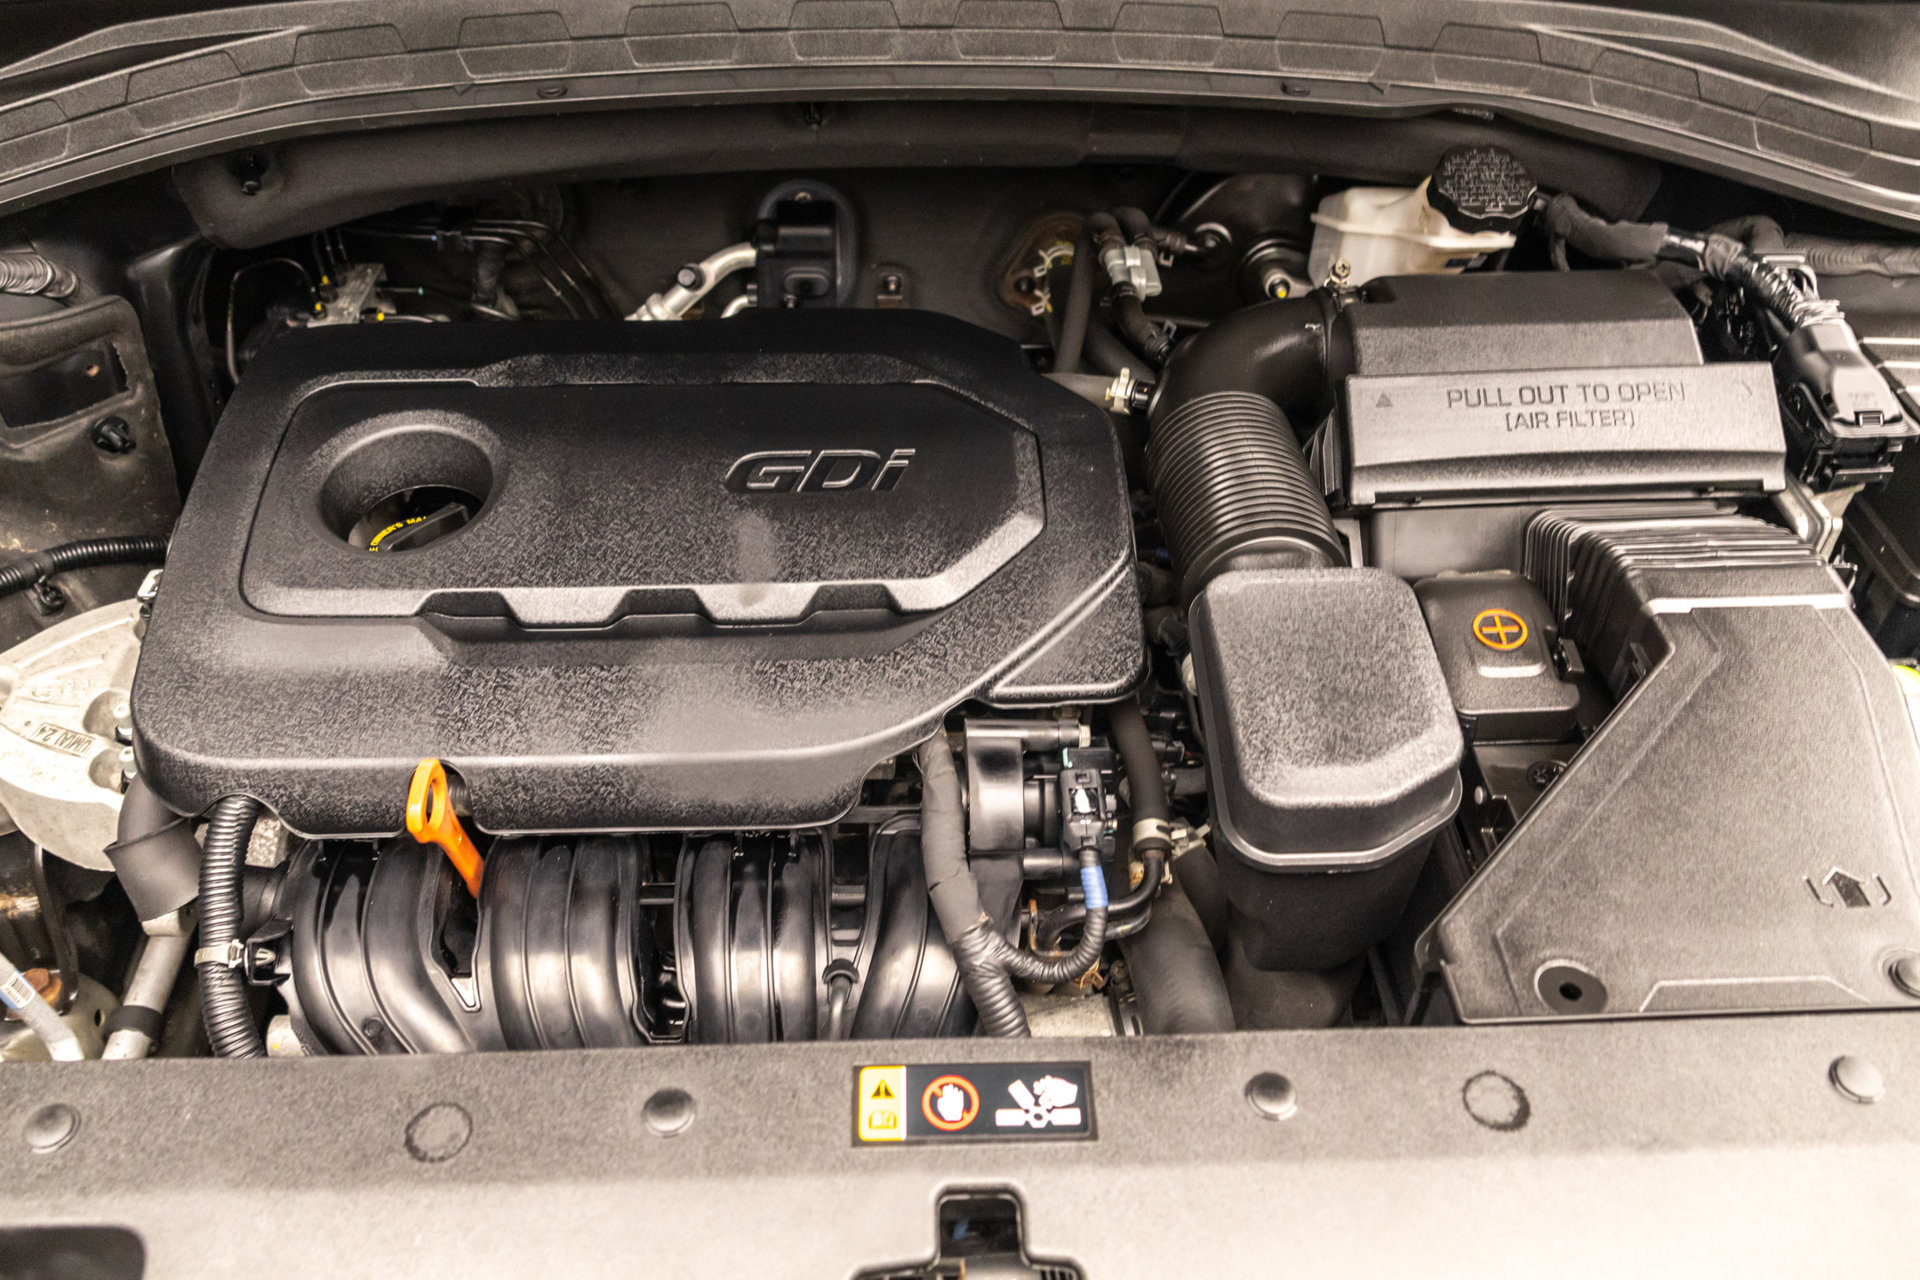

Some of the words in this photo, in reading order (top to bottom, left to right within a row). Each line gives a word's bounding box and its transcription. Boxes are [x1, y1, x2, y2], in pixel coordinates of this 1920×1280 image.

[1446, 388, 1512, 409] PULL
[1518, 385, 1569, 406] OUT
[1576, 382, 1610, 403] TO
[1617, 381, 1686, 402] OPEN
